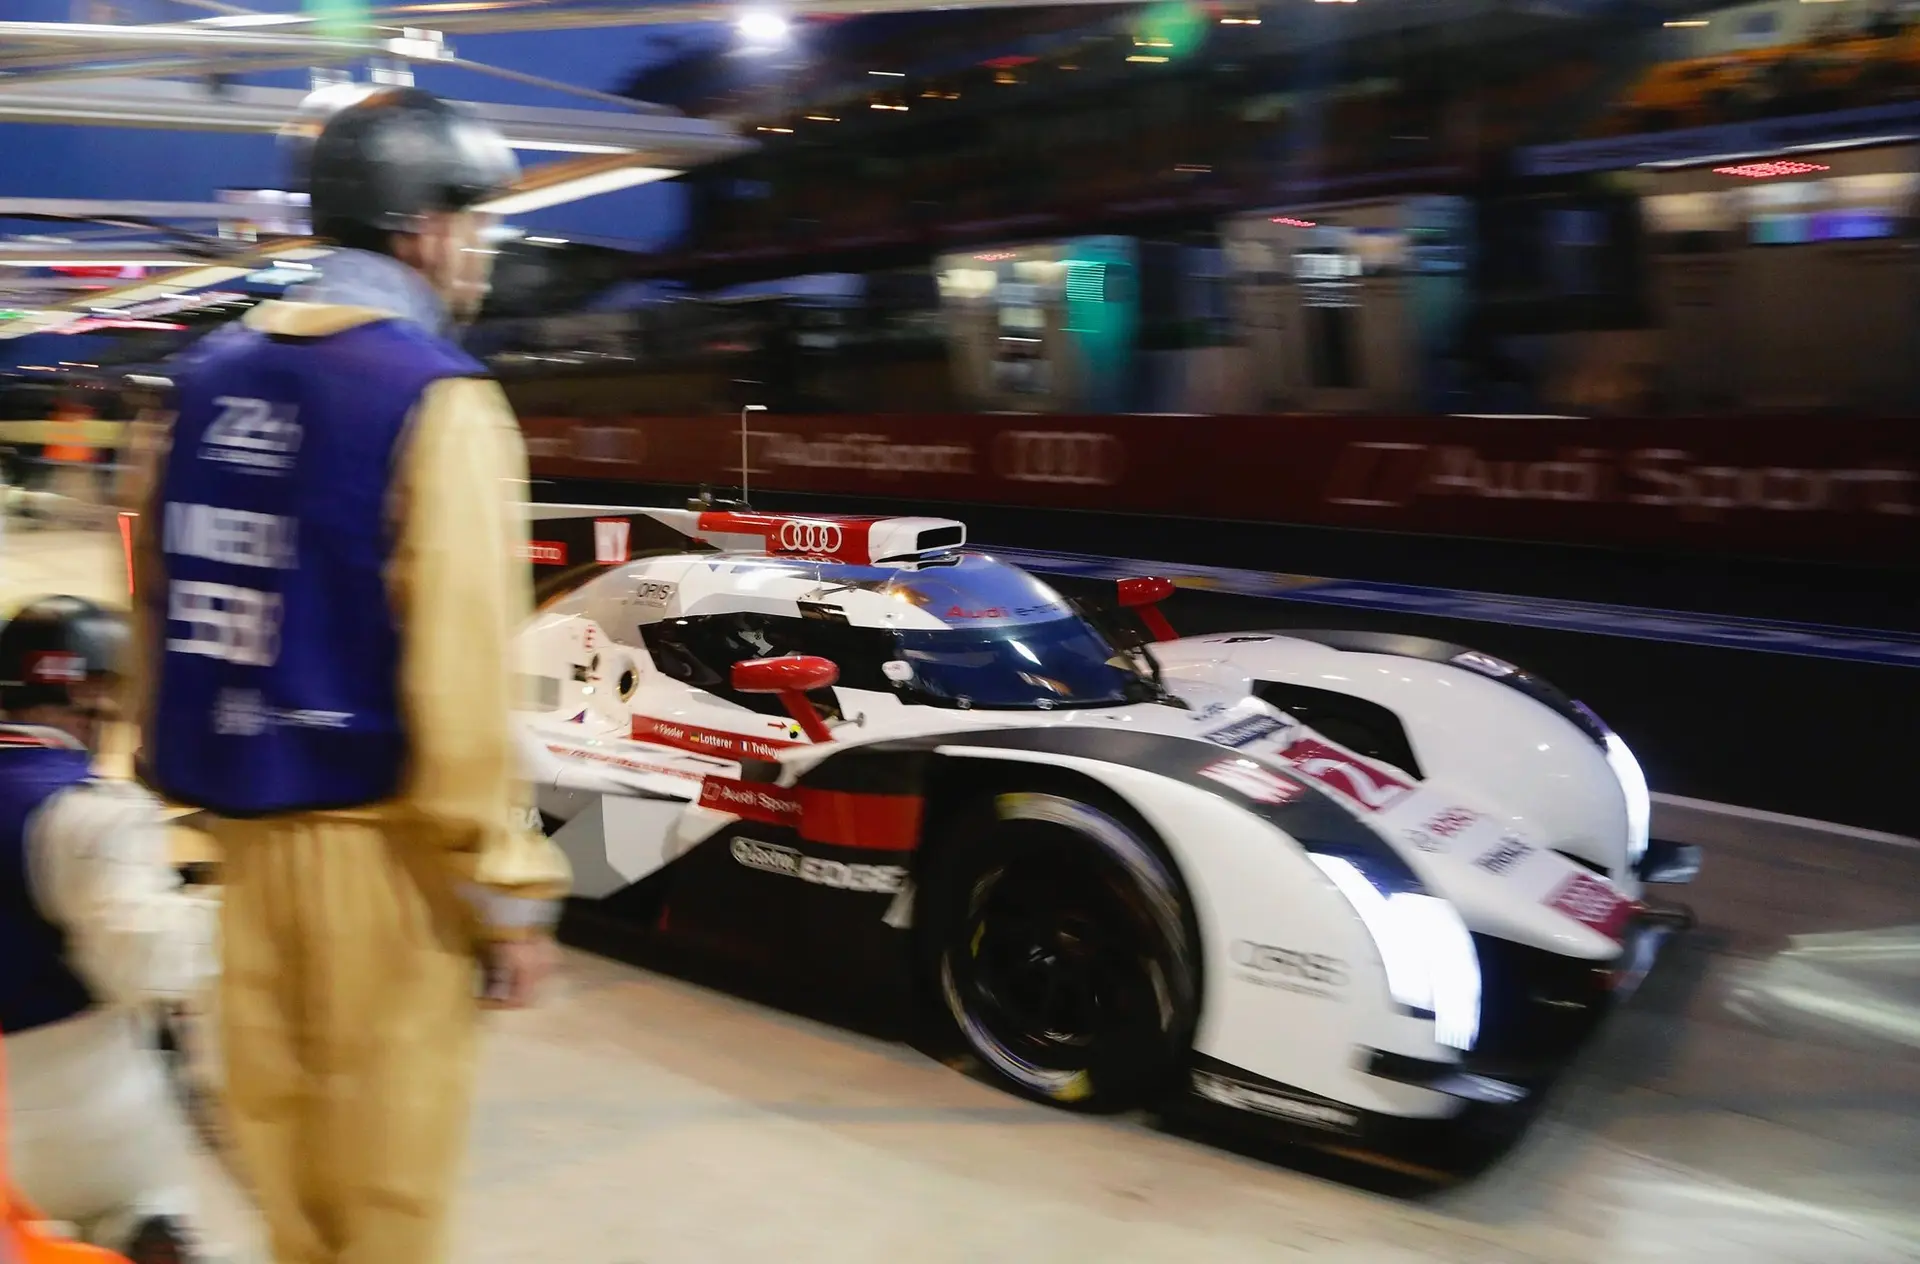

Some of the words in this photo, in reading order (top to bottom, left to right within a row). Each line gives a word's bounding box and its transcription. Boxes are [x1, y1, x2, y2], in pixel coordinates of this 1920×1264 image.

[1422, 445, 1612, 501] Audi
[1624, 447, 1920, 523] Sport
[637, 582, 672, 600] ORIS
[945, 604, 1010, 619] Audi
[700, 732, 733, 749] Lotterer
[752, 743, 781, 760] Tréluy
[1298, 756, 1403, 808] 2
[720, 785, 758, 806] Audi
[758, 791, 804, 817] Sport
